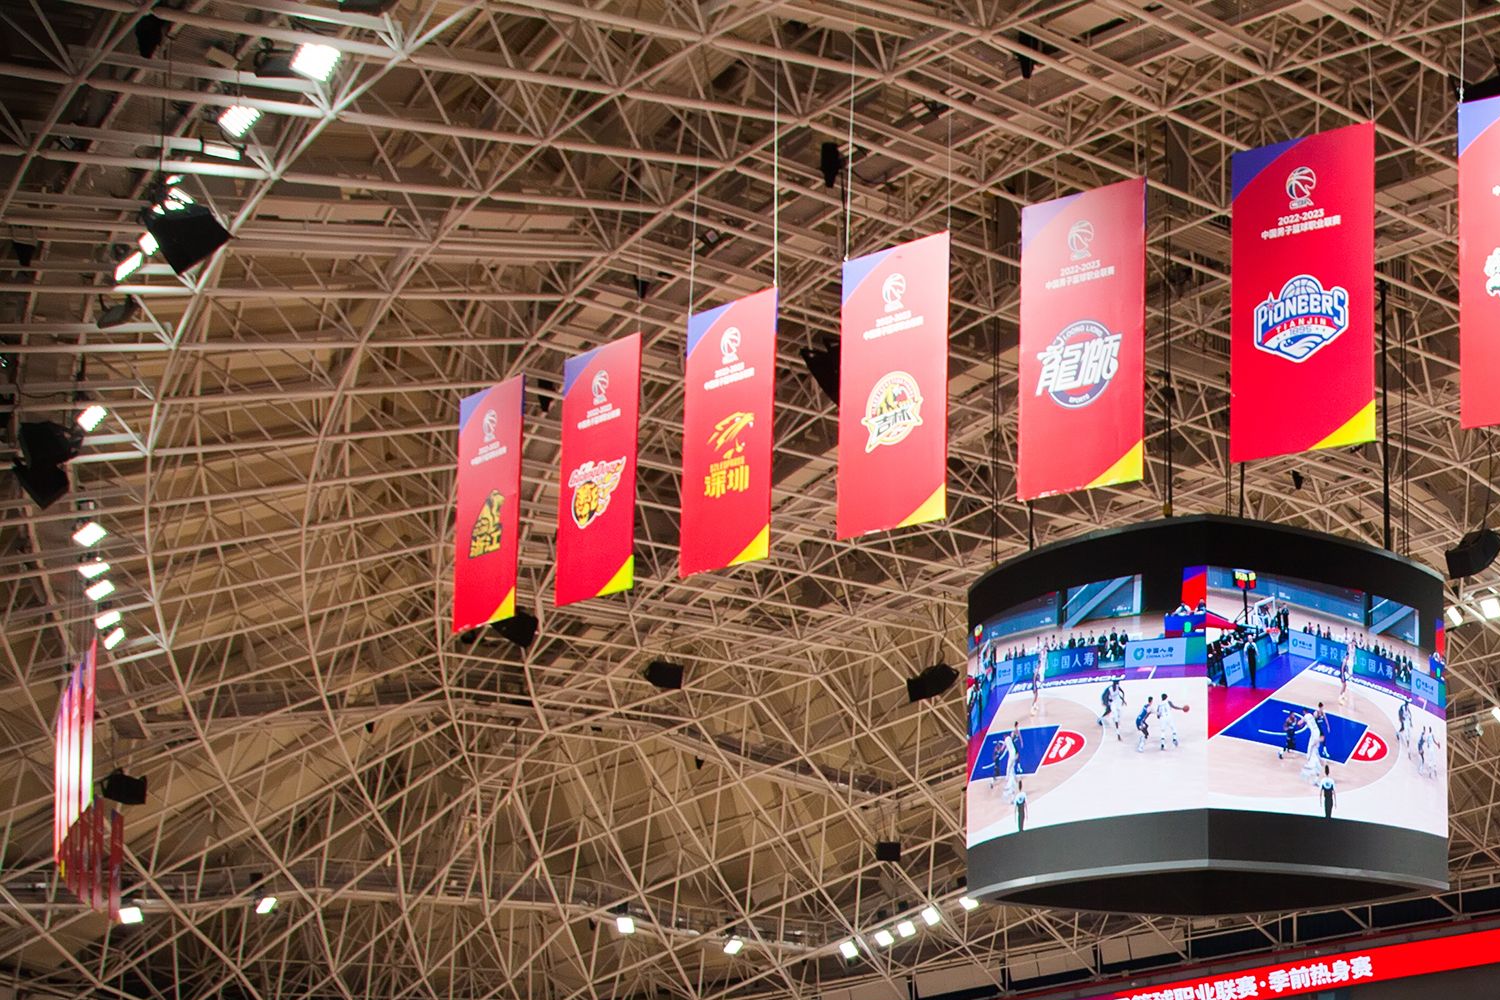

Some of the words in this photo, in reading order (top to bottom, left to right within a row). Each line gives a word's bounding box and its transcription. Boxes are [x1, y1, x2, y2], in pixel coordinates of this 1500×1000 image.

[1278, 208, 1325, 226] 2022-2023
[1257, 290, 1346, 345] PIONEERS
[1275, 316, 1327, 334] TIANJIN
[704, 465, 750, 499] 深圳
